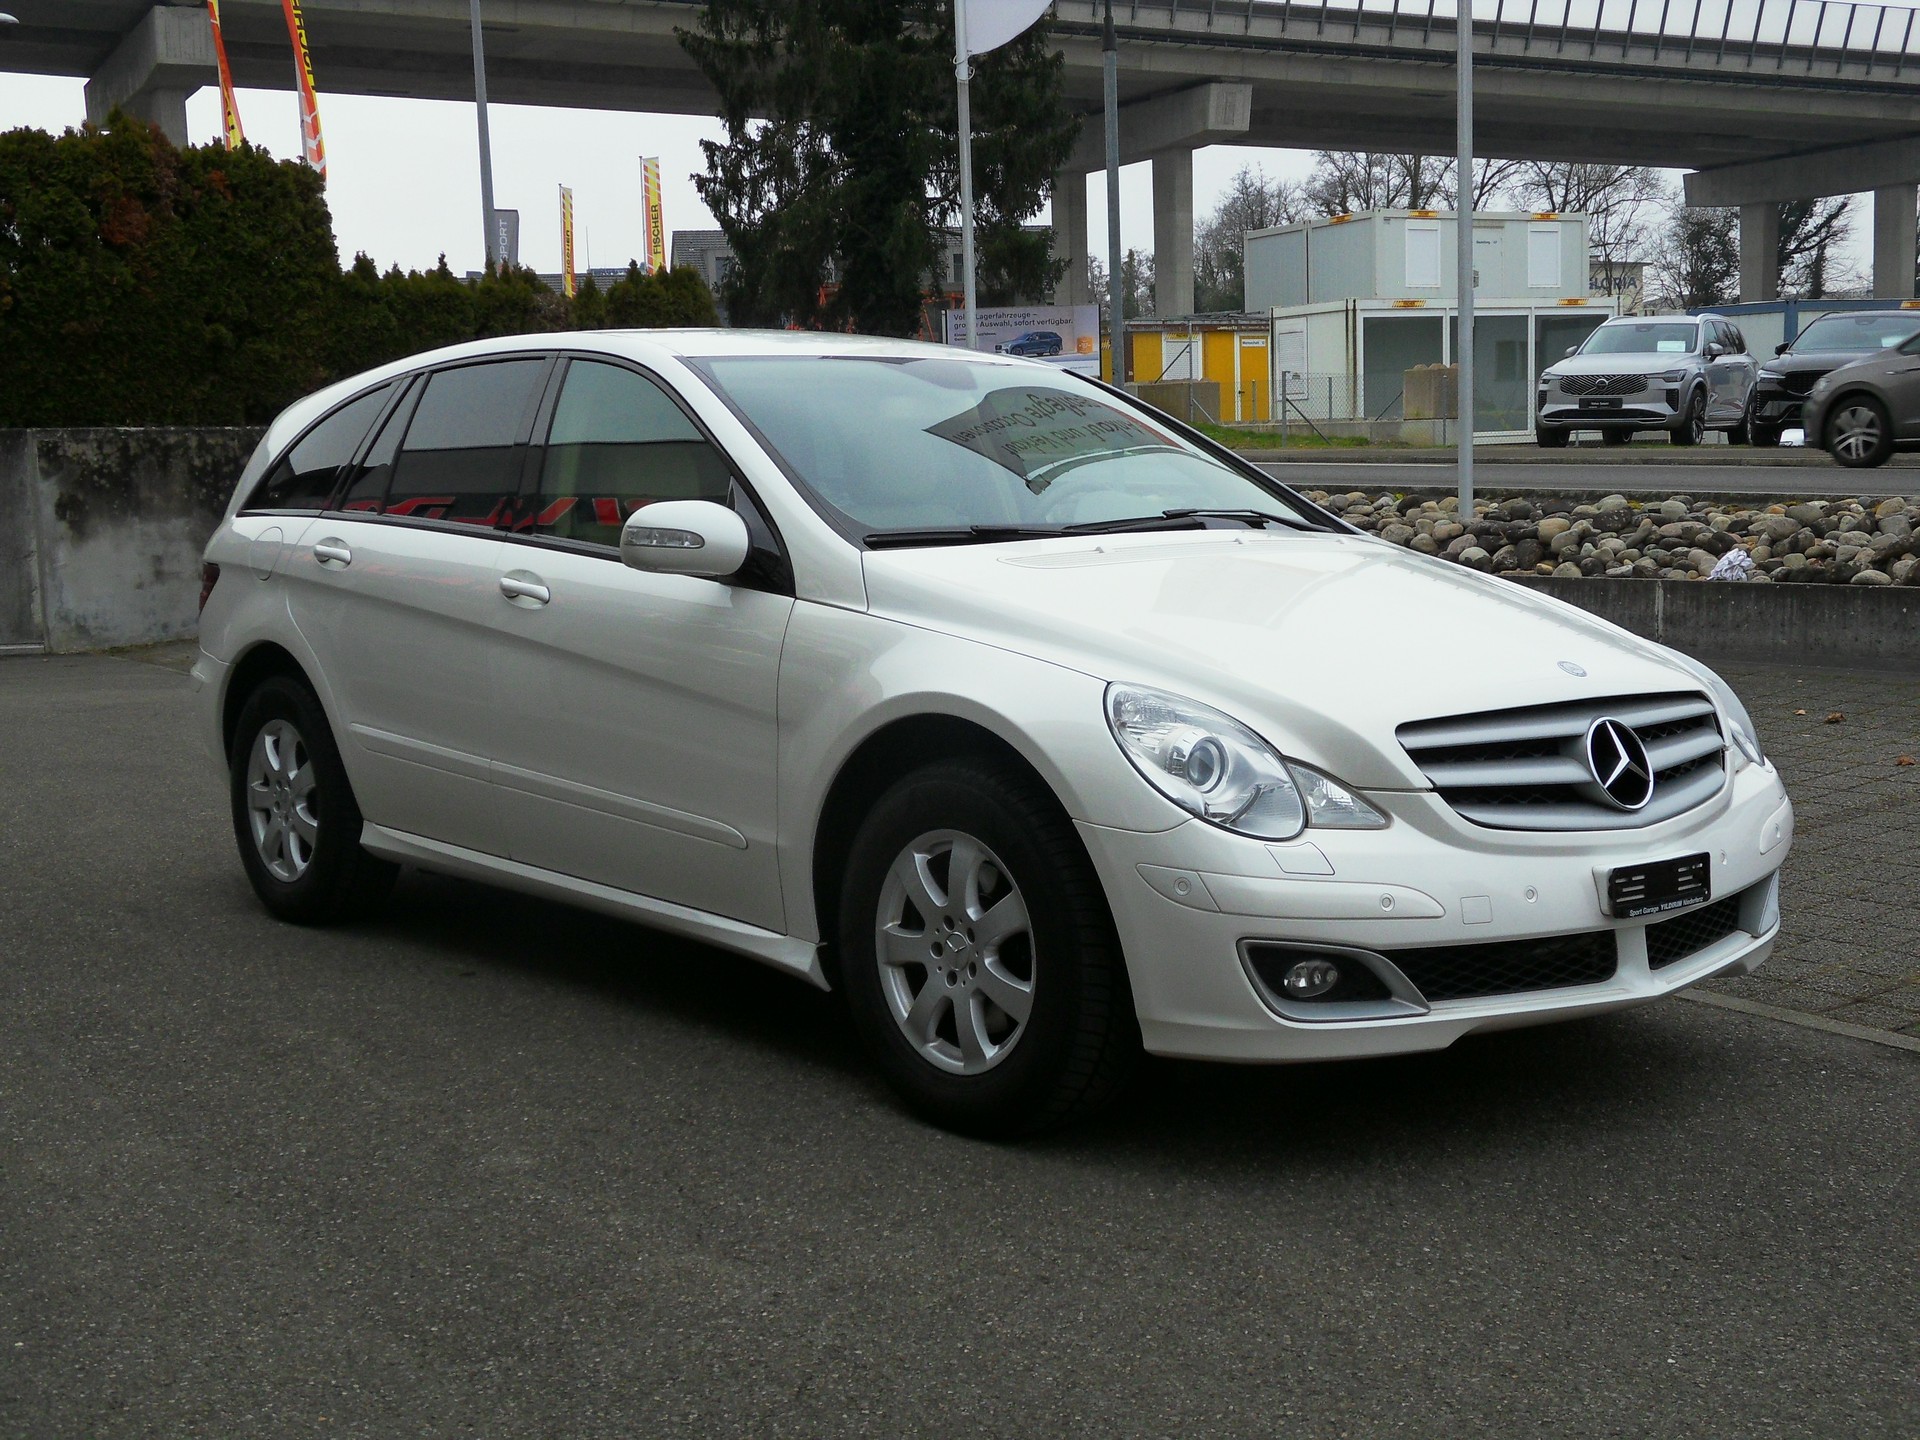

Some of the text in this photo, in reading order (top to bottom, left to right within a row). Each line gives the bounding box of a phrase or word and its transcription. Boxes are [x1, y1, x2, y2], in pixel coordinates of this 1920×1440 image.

[651, 204, 661, 254] FISCHER
[975, 312, 1031, 321] Lagerfahrzeuge
[1013, 319, 1035, 327] sofort
[1629, 908, 1643, 917] Sport
[1643, 906, 1659, 914] Garage
